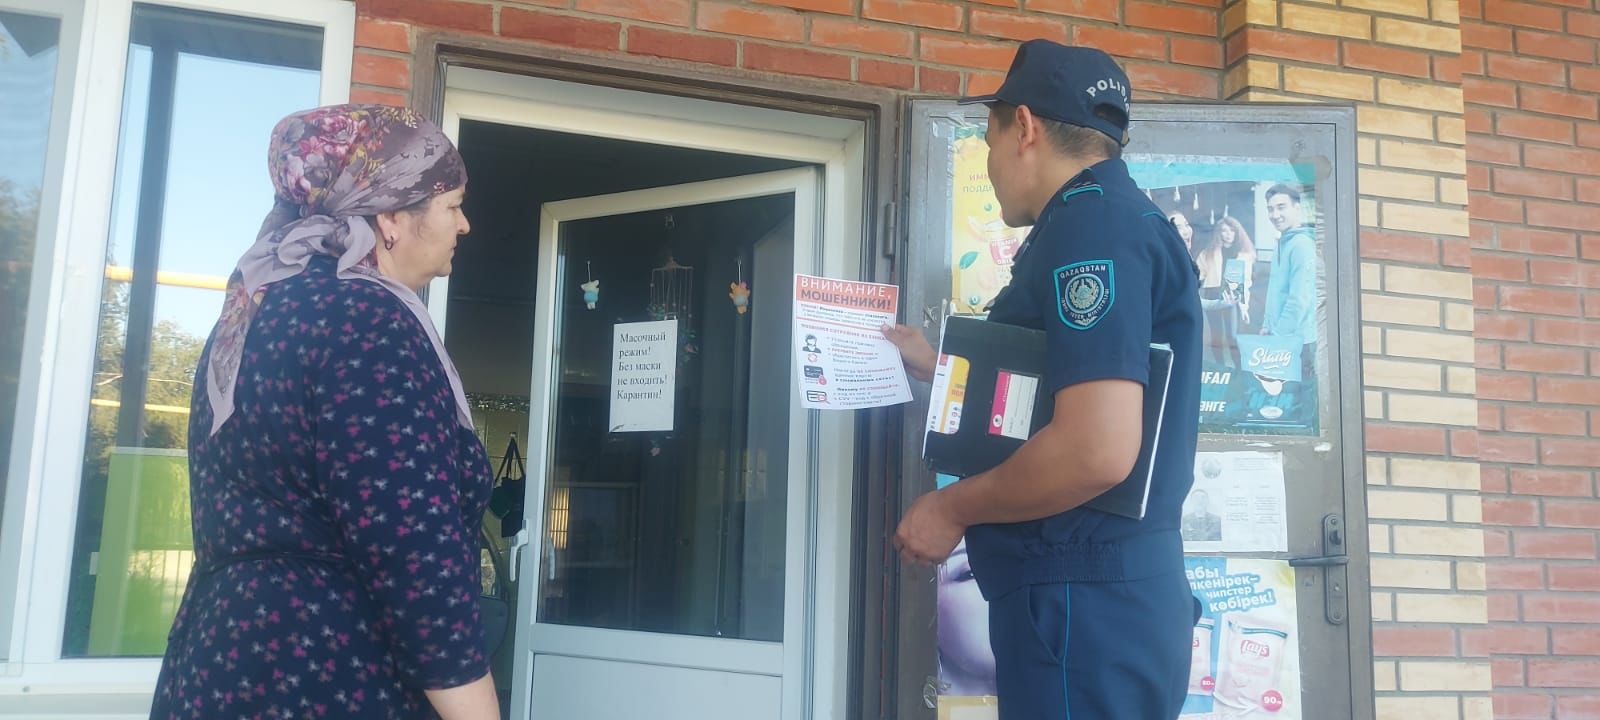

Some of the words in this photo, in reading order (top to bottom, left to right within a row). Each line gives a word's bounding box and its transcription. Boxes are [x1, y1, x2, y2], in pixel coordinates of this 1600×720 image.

[1060, 265, 1106, 279] QAZAQSTAN
[801, 278, 892, 299] ВНИМАНИЕ,
[801, 290, 892, 310] МОШЕННИКИ!
[620, 331, 666, 343] Масочный
[619, 346, 651, 359] режим!
[1248, 347, 1292, 367] Slang
[618, 361, 633, 371] Без
[635, 362, 661, 371] маски
[617, 377, 628, 386] не
[630, 374, 667, 387] входить!
[617, 389, 662, 402] Карантин!
[1206, 586, 1252, 598] чипстер
[1209, 591, 1272, 612] көбірек!
